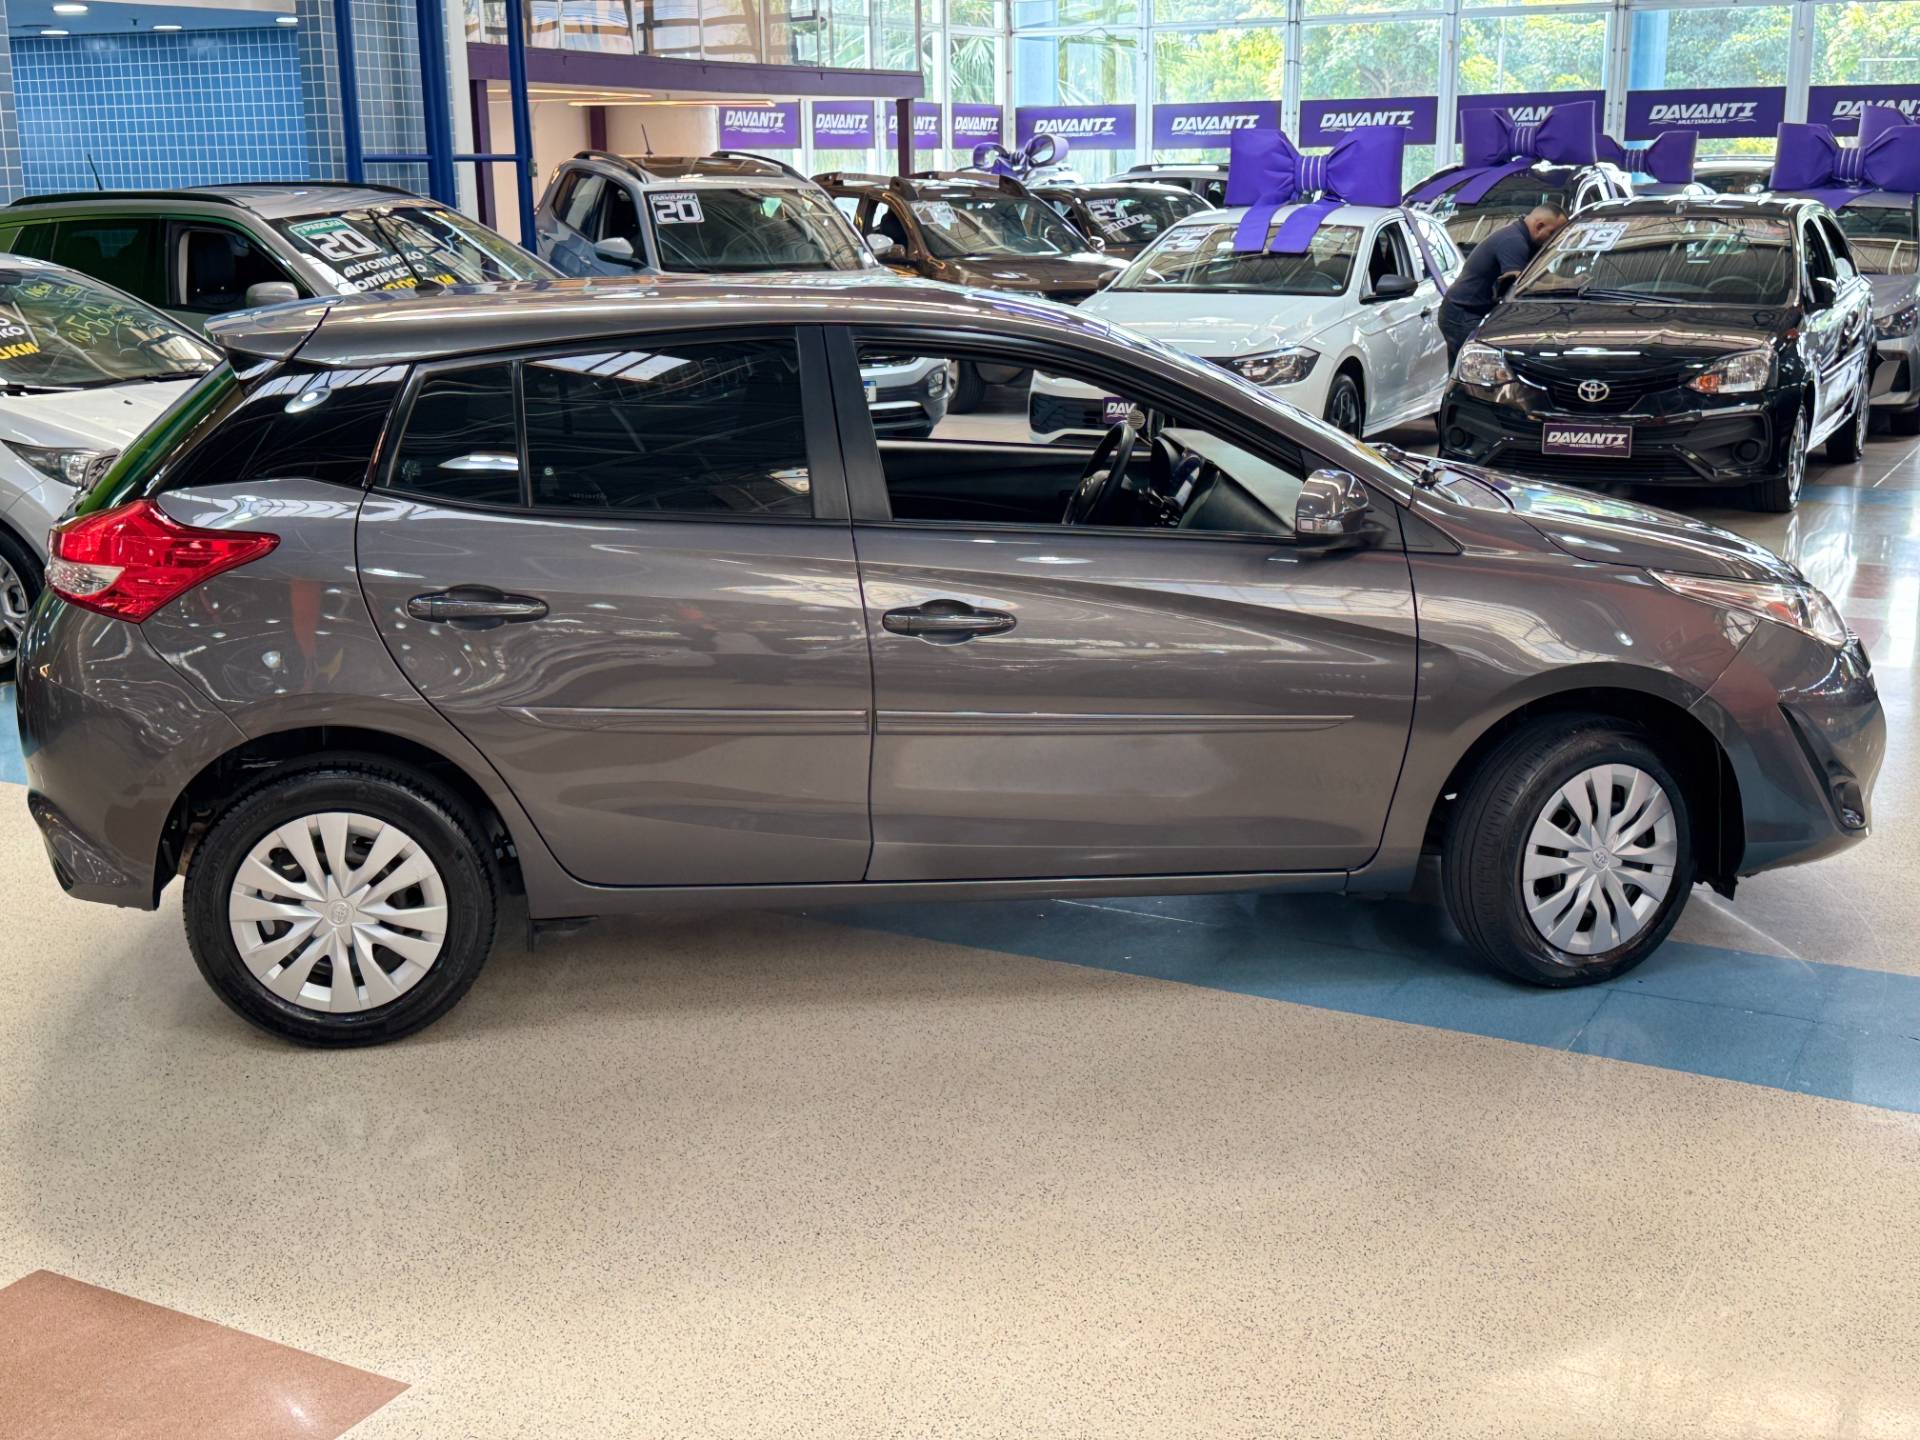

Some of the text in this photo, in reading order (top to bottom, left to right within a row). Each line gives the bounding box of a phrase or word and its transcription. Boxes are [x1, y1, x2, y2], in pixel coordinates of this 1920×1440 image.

[725, 110, 786, 128] DAVANTI
[1320, 110, 1415, 128] DAVANTI
[1648, 102, 1758, 120] DAVANTI
[816, 113, 869, 129] DAVANTI
[955, 116, 999, 130] DAVANTI
[1034, 117, 1117, 133] DAVANTI
[1171, 114, 1260, 131] DAVANTI
[653, 200, 702, 221] 20
[309, 230, 378, 260] 20
[343, 251, 424, 279] AUTOMAICO
[1546, 431, 1628, 446] DAVANTI
